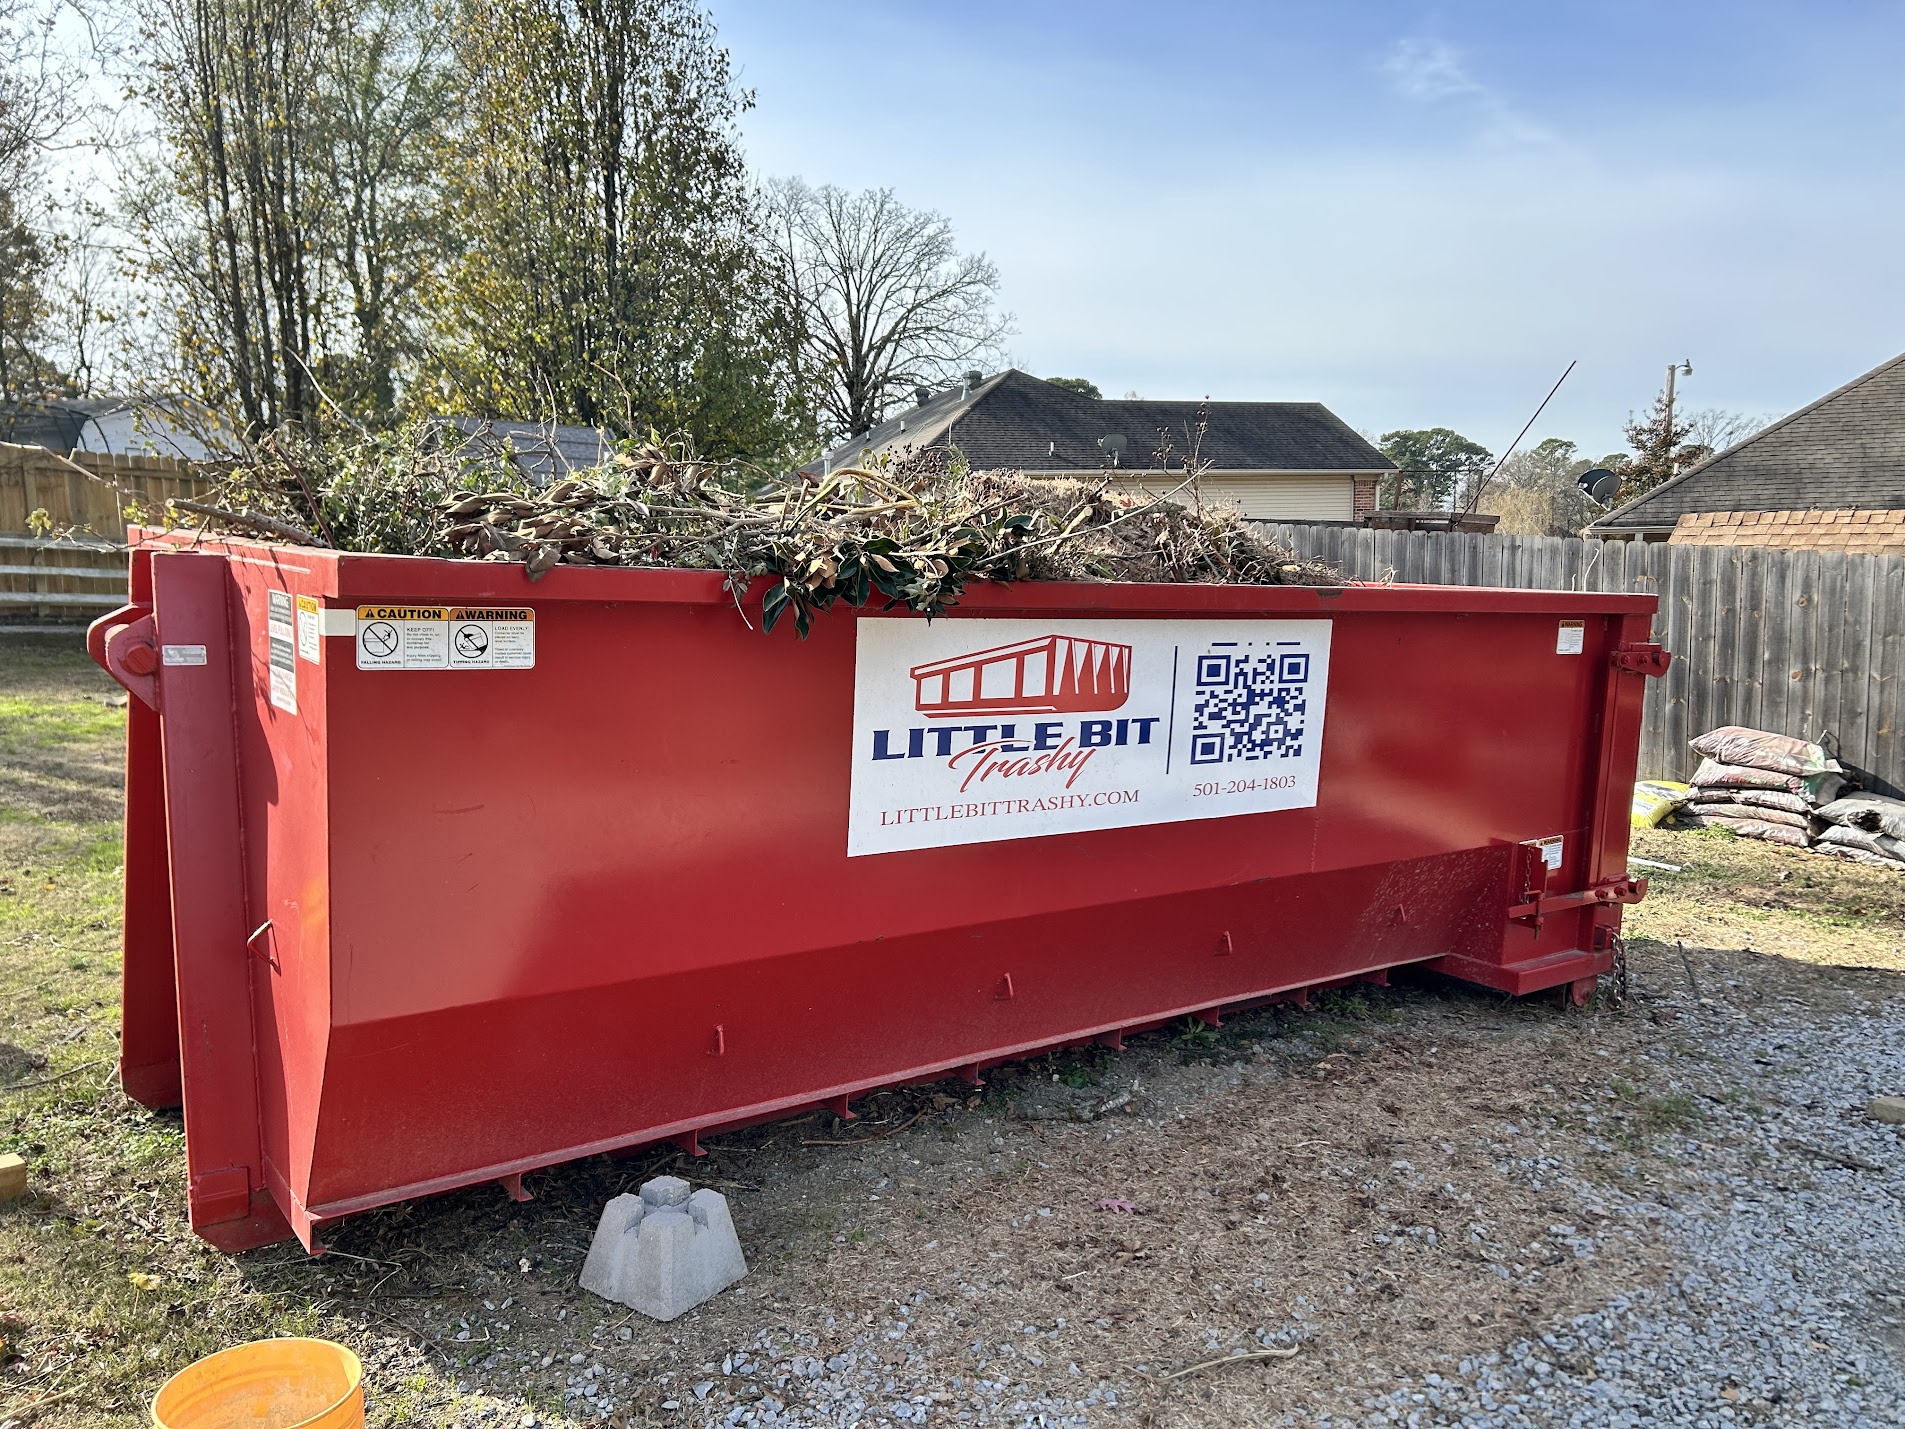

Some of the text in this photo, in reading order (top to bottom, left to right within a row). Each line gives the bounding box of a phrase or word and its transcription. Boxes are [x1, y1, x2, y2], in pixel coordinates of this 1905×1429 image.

[377, 608, 442, 619] CAUTION
[465, 610, 528, 620] WARNING
[872, 717, 1160, 761] LITTLE BIT
[948, 736, 1096, 793] Trashy
[1193, 775, 1297, 797] 501-204-1803
[881, 789, 1141, 826] LITTLEBITTRASHY.COM
